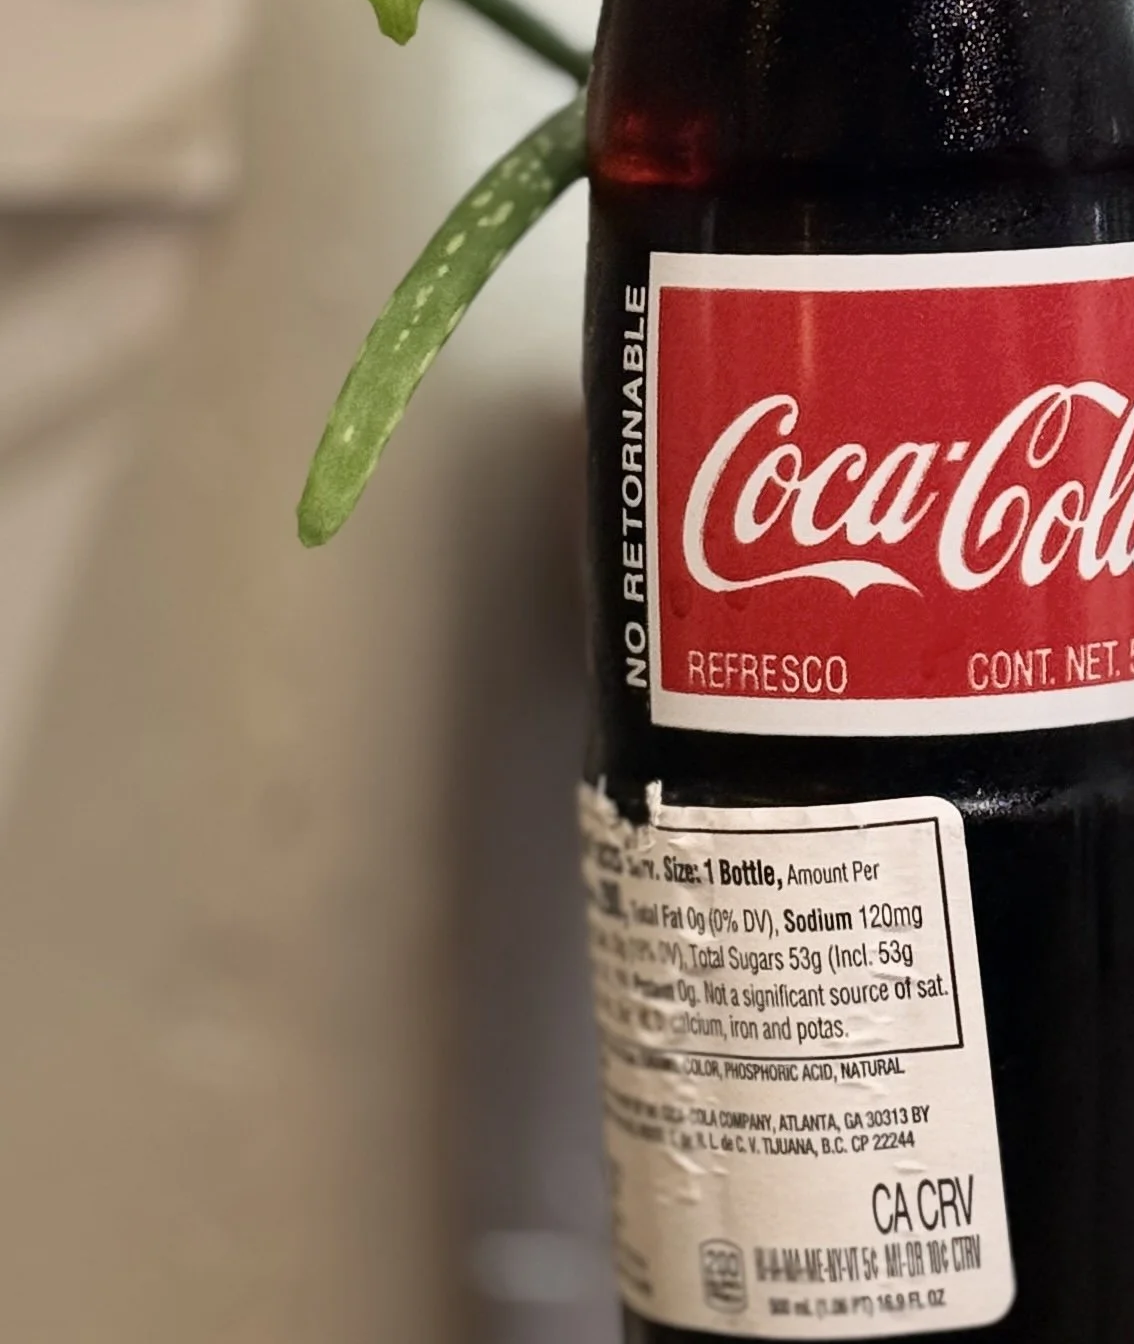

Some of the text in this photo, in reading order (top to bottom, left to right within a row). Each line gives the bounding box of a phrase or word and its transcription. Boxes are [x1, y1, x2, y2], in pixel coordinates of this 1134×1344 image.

[622, 285, 648, 688] NO RETORNABLE
[687, 650, 849, 694] REFRESCO
[967, 649, 1056, 692] CONT.
[1065, 640, 1121, 684] NET.
[662, 855, 702, 883] Size:
[703, 858, 714, 884] 1
[719, 858, 783, 890] Bottle,
[787, 863, 849, 886] Amount
[852, 860, 880, 882] Per
[662, 904, 684, 930] Fat
[687, 906, 705, 936] 0g
[709, 908, 739, 938] (0%
[743, 909, 780, 940] DV),
[784, 908, 853, 933] Sodium
[859, 902, 923, 930] 120mg
[688, 944, 724, 969] Total
[728, 945, 784, 976] Sugars
[789, 946, 822, 975] 53g
[828, 942, 873, 975] (Incl.
[878, 939, 913, 968] 53g
[703, 980, 729, 1006] Not
[730, 989, 739, 1007] a
[743, 983, 826, 1012] significant
[830, 981, 889, 1006] source
[894, 975, 912, 1000] of
[917, 973, 949, 998] sat.
[729, 1014, 759, 1040] iron
[762, 1016, 792, 1041] and
[797, 1018, 849, 1045] potas.
[725, 1063, 799, 1082] PHOSPHORIC
[802, 1063, 838, 1083] ACID,
[840, 1057, 906, 1080] NATURAL
[719, 1110, 777, 1136] COMPANY,
[779, 1113, 841, 1134] ATLANTA,
[844, 1111, 864, 1131] GA
[866, 1107, 909, 1128] 30313
[911, 1105, 931, 1124] BY
[762, 1137, 818, 1157] TIJUANA,
[821, 1137, 848, 1154] B.C.
[851, 1135, 869, 1153] CP
[873, 1130, 915, 1151] 22244
[872, 1174, 974, 1235] CA CRV
[862, 1246, 879, 1281] 5¢
[884, 1240, 925, 1279] MI-OR
[926, 1239, 949, 1275] 10¢
[927, 1288, 946, 1307] OZ
